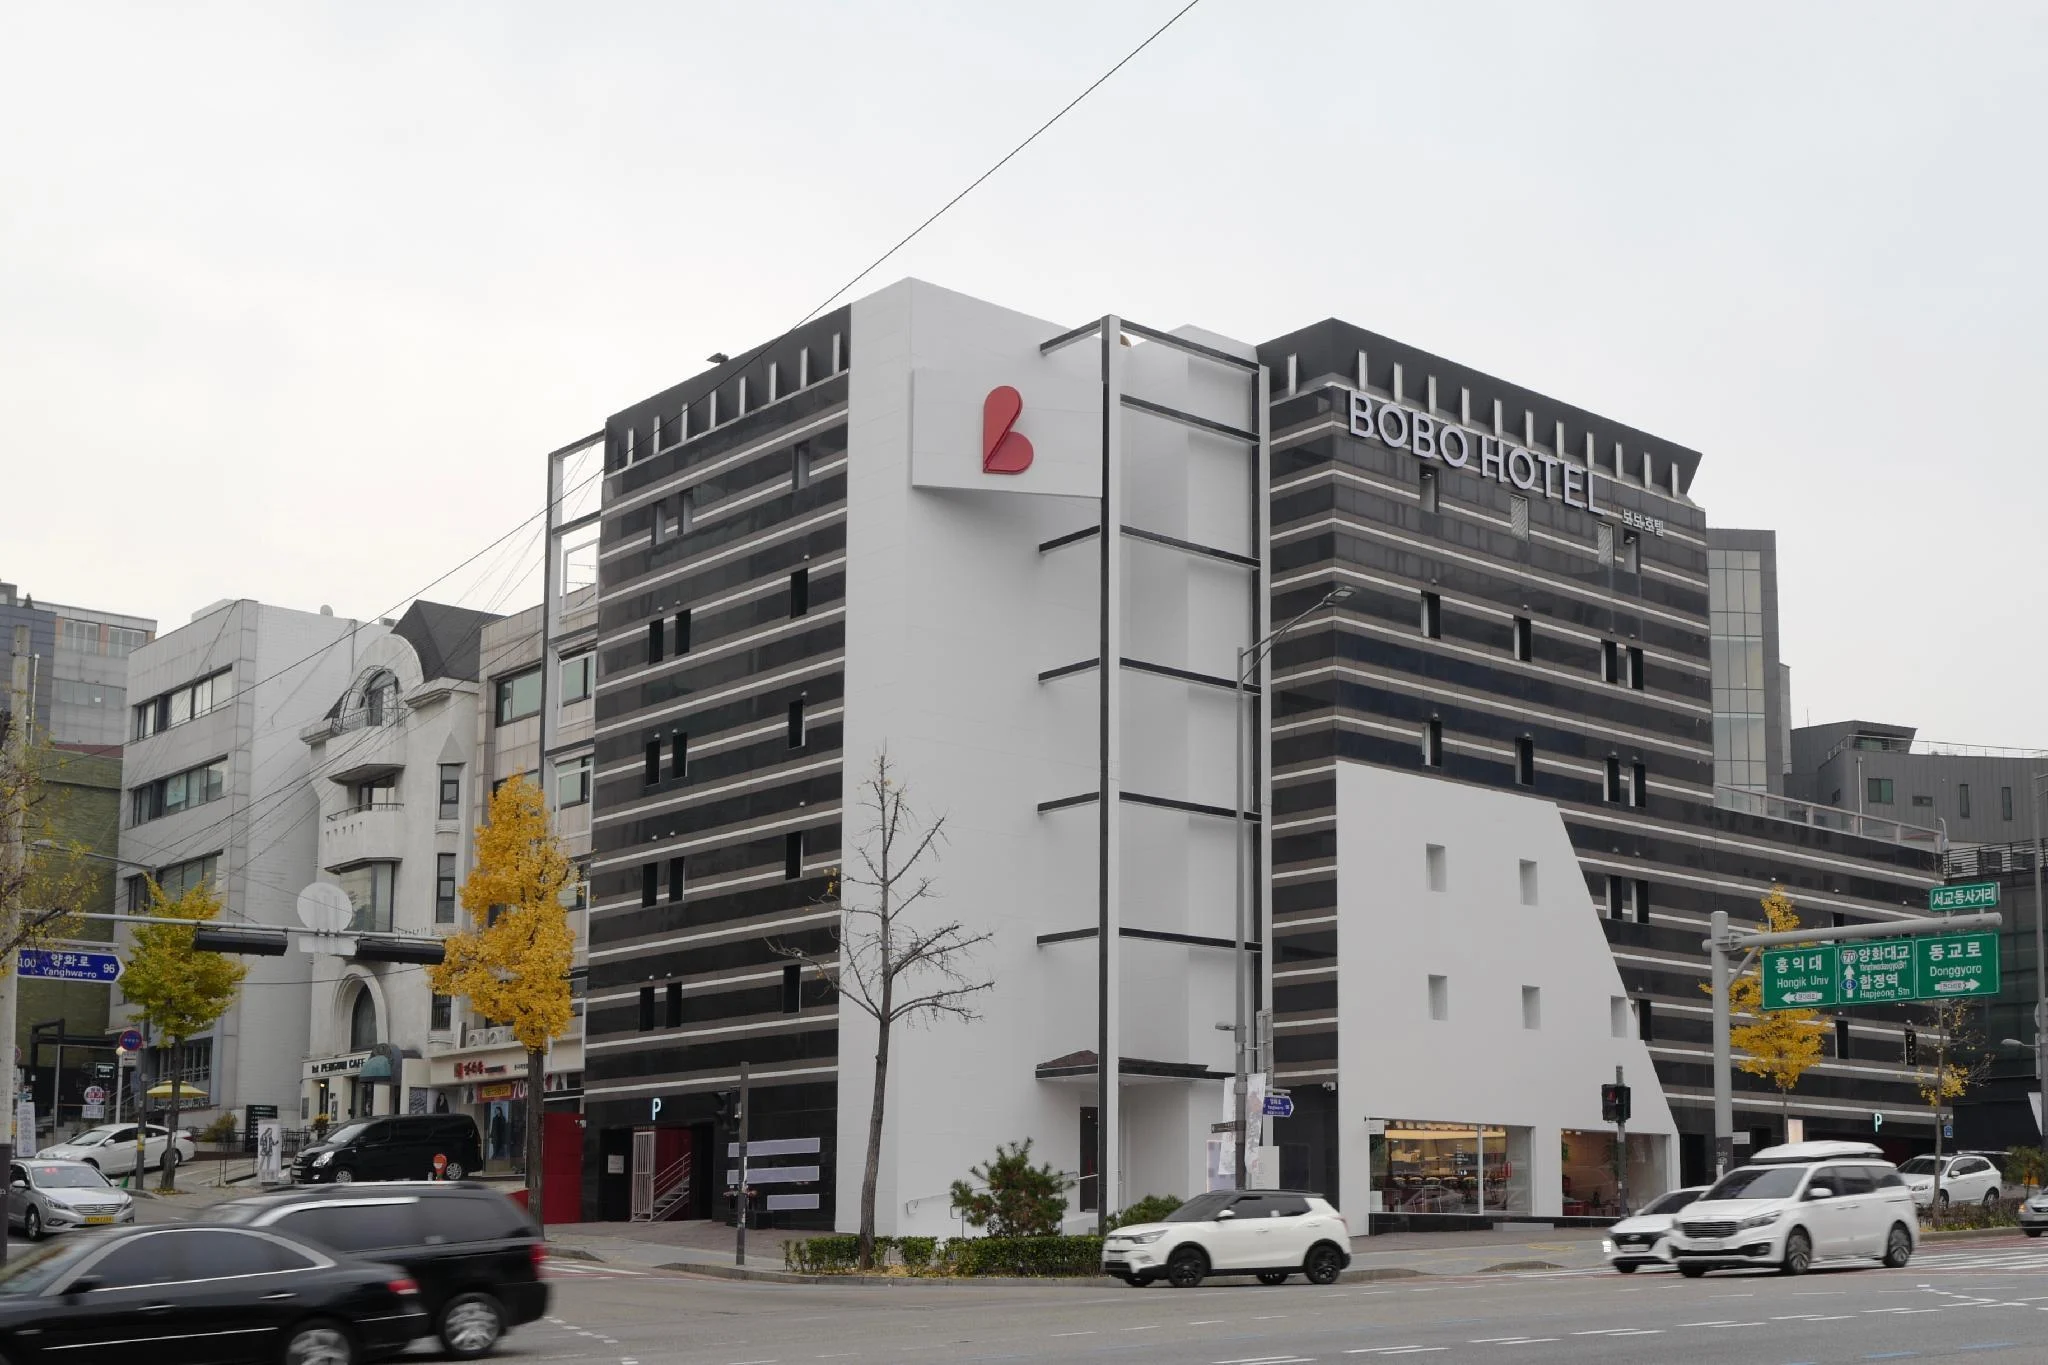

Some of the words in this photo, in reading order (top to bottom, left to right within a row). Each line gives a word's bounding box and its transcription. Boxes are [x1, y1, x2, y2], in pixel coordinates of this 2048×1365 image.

[1350, 390, 1468, 468] BOBO
[1480, 434, 1608, 515] HOTEL
[1622, 509, 1664, 537] 보보호텔
[1933, 886, 1995, 906] 서교동사거리
[51, 953, 91, 967] 양화로
[1859, 945, 1910, 963] 양화대교
[1928, 941, 1983, 961] 동교로
[43, 966, 97, 978] Yanghwa-ro
[103, 963, 115, 973] 96
[1775, 954, 1822, 974] 홍익대
[1777, 977, 1807, 990] Hongik
[1810, 975, 1829, 986] Univ
[1859, 972, 1898, 990] 합정역
[1860, 989, 1895, 999] Hapjeong
[652, 1098, 662, 1121] P
[1874, 1113, 1883, 1132] P
